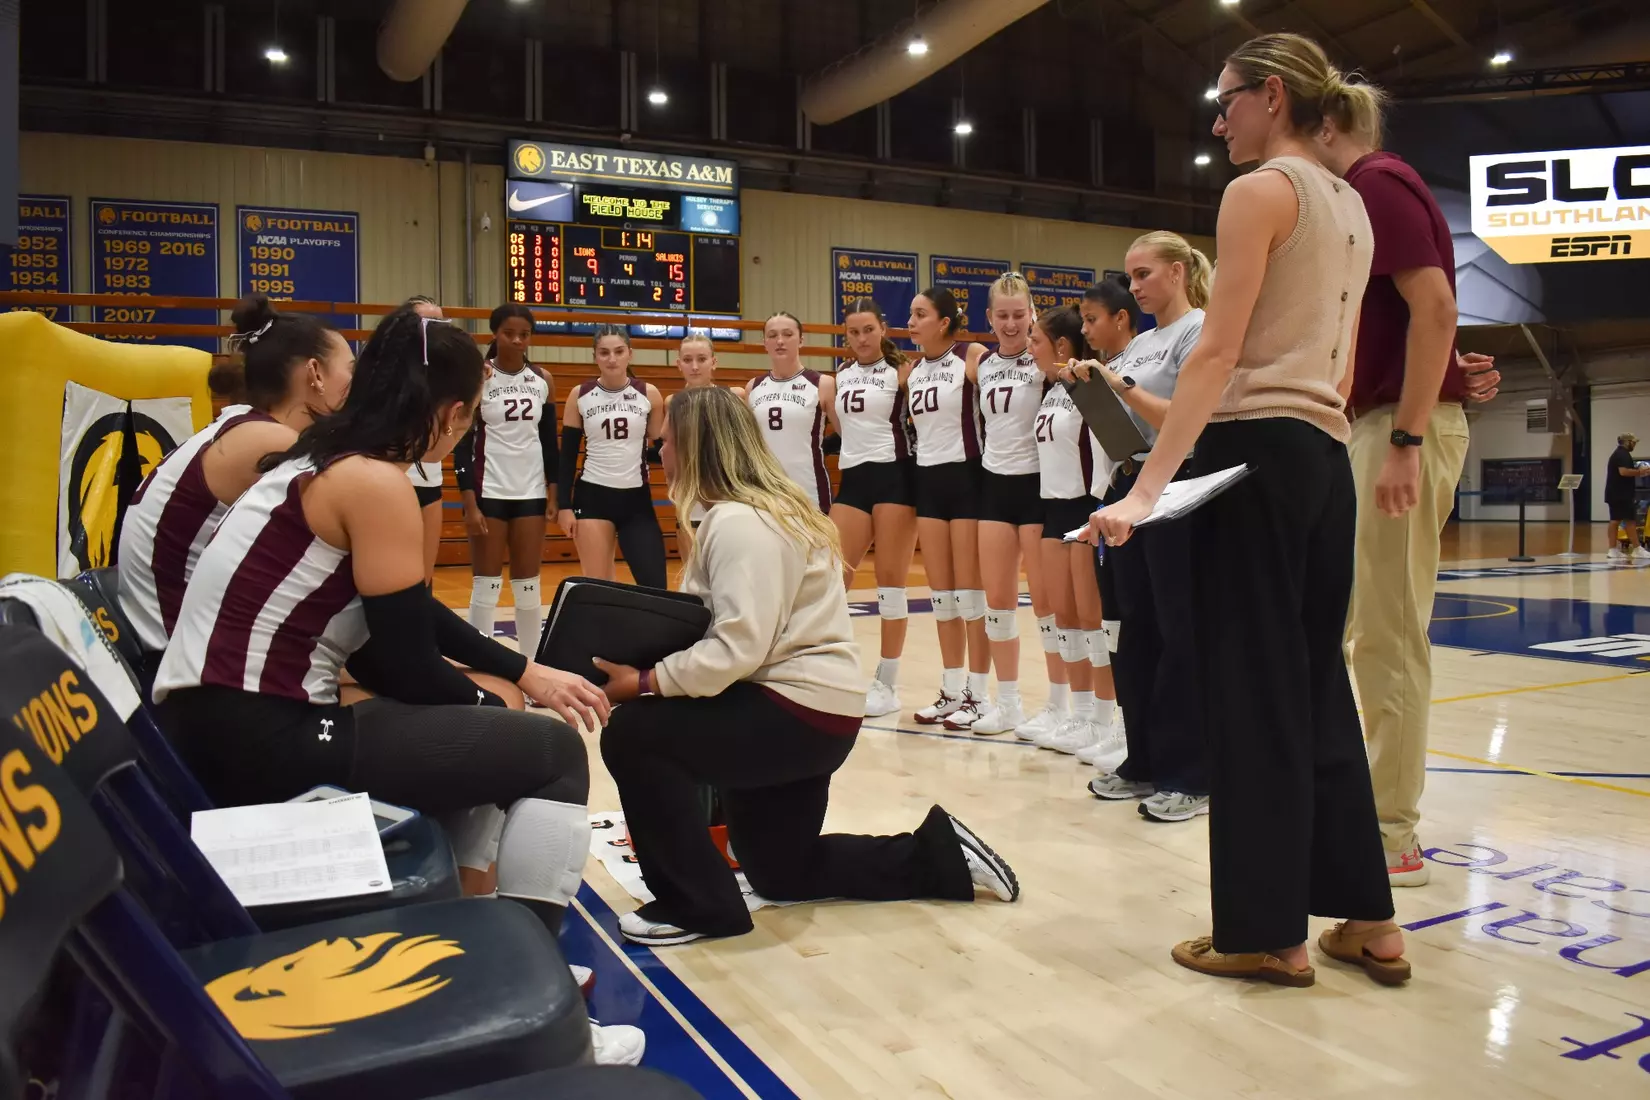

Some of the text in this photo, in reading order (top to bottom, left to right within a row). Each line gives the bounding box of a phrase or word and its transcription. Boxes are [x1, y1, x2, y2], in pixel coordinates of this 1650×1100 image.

[551, 150, 733, 184] EAST TEXAS A&M
[583, 195, 670, 210] WELCOME TO THE
[20, 206, 66, 218] BALL
[121, 210, 214, 225] FOOTBALL
[590, 204, 663, 220] FIELD HOUSE
[266, 217, 354, 233] FOOTBALL
[12, 237, 58, 251] 952
[256, 235, 341, 247] NCAA PLAYOFFS
[510, 233, 524, 244] 02
[535, 234, 541, 245] 3
[621, 231, 652, 248] 1:14
[1550, 234, 1632, 258] ESPN
[104, 239, 206, 256] 1969 2016
[249, 246, 296, 261] 1990
[510, 244, 559, 257] 03 0 0
[573, 247, 596, 257] LIONS
[10, 253, 59, 268] 1953
[104, 256, 149, 271] 1972
[510, 256, 559, 269] 07 0 0
[655, 252, 684, 263] SALUKIS
[853, 259, 913, 270] VOLLEYBALL
[249, 262, 290, 277] 1991
[514, 268, 559, 280] 11 0 10
[587, 258, 598, 275] 9
[623, 263, 633, 276] 4
[669, 263, 684, 281] 15
[10, 271, 60, 285] 1954
[104, 274, 151, 288] 1983
[839, 271, 912, 282] NCAA TOURNAMENT
[249, 279, 296, 294] 1995
[514, 279, 559, 292] 16 0 10
[580, 283, 584, 296] 1
[599, 285, 604, 297] 1
[841, 281, 873, 293] 1986
[514, 291, 526, 301] 18
[534, 291, 542, 302] 0
[652, 287, 662, 301] 2
[675, 288, 684, 302] 2
[841, 295, 873, 305] 19
[1033, 294, 1056, 306] 939
[104, 308, 156, 322] 2007
[489, 385, 518, 400] SOUTHERN
[782, 392, 806, 407] ILLINOIS
[987, 386, 1013, 414] 17
[840, 389, 866, 414] 15
[911, 386, 939, 415] 20
[504, 398, 534, 421] 22
[586, 403, 643, 419] SOUTHERN ILLINOIS
[768, 406, 783, 430] 8
[601, 417, 629, 440] 18
[1035, 412, 1055, 442] 21
[13, 669, 98, 766] IONS
